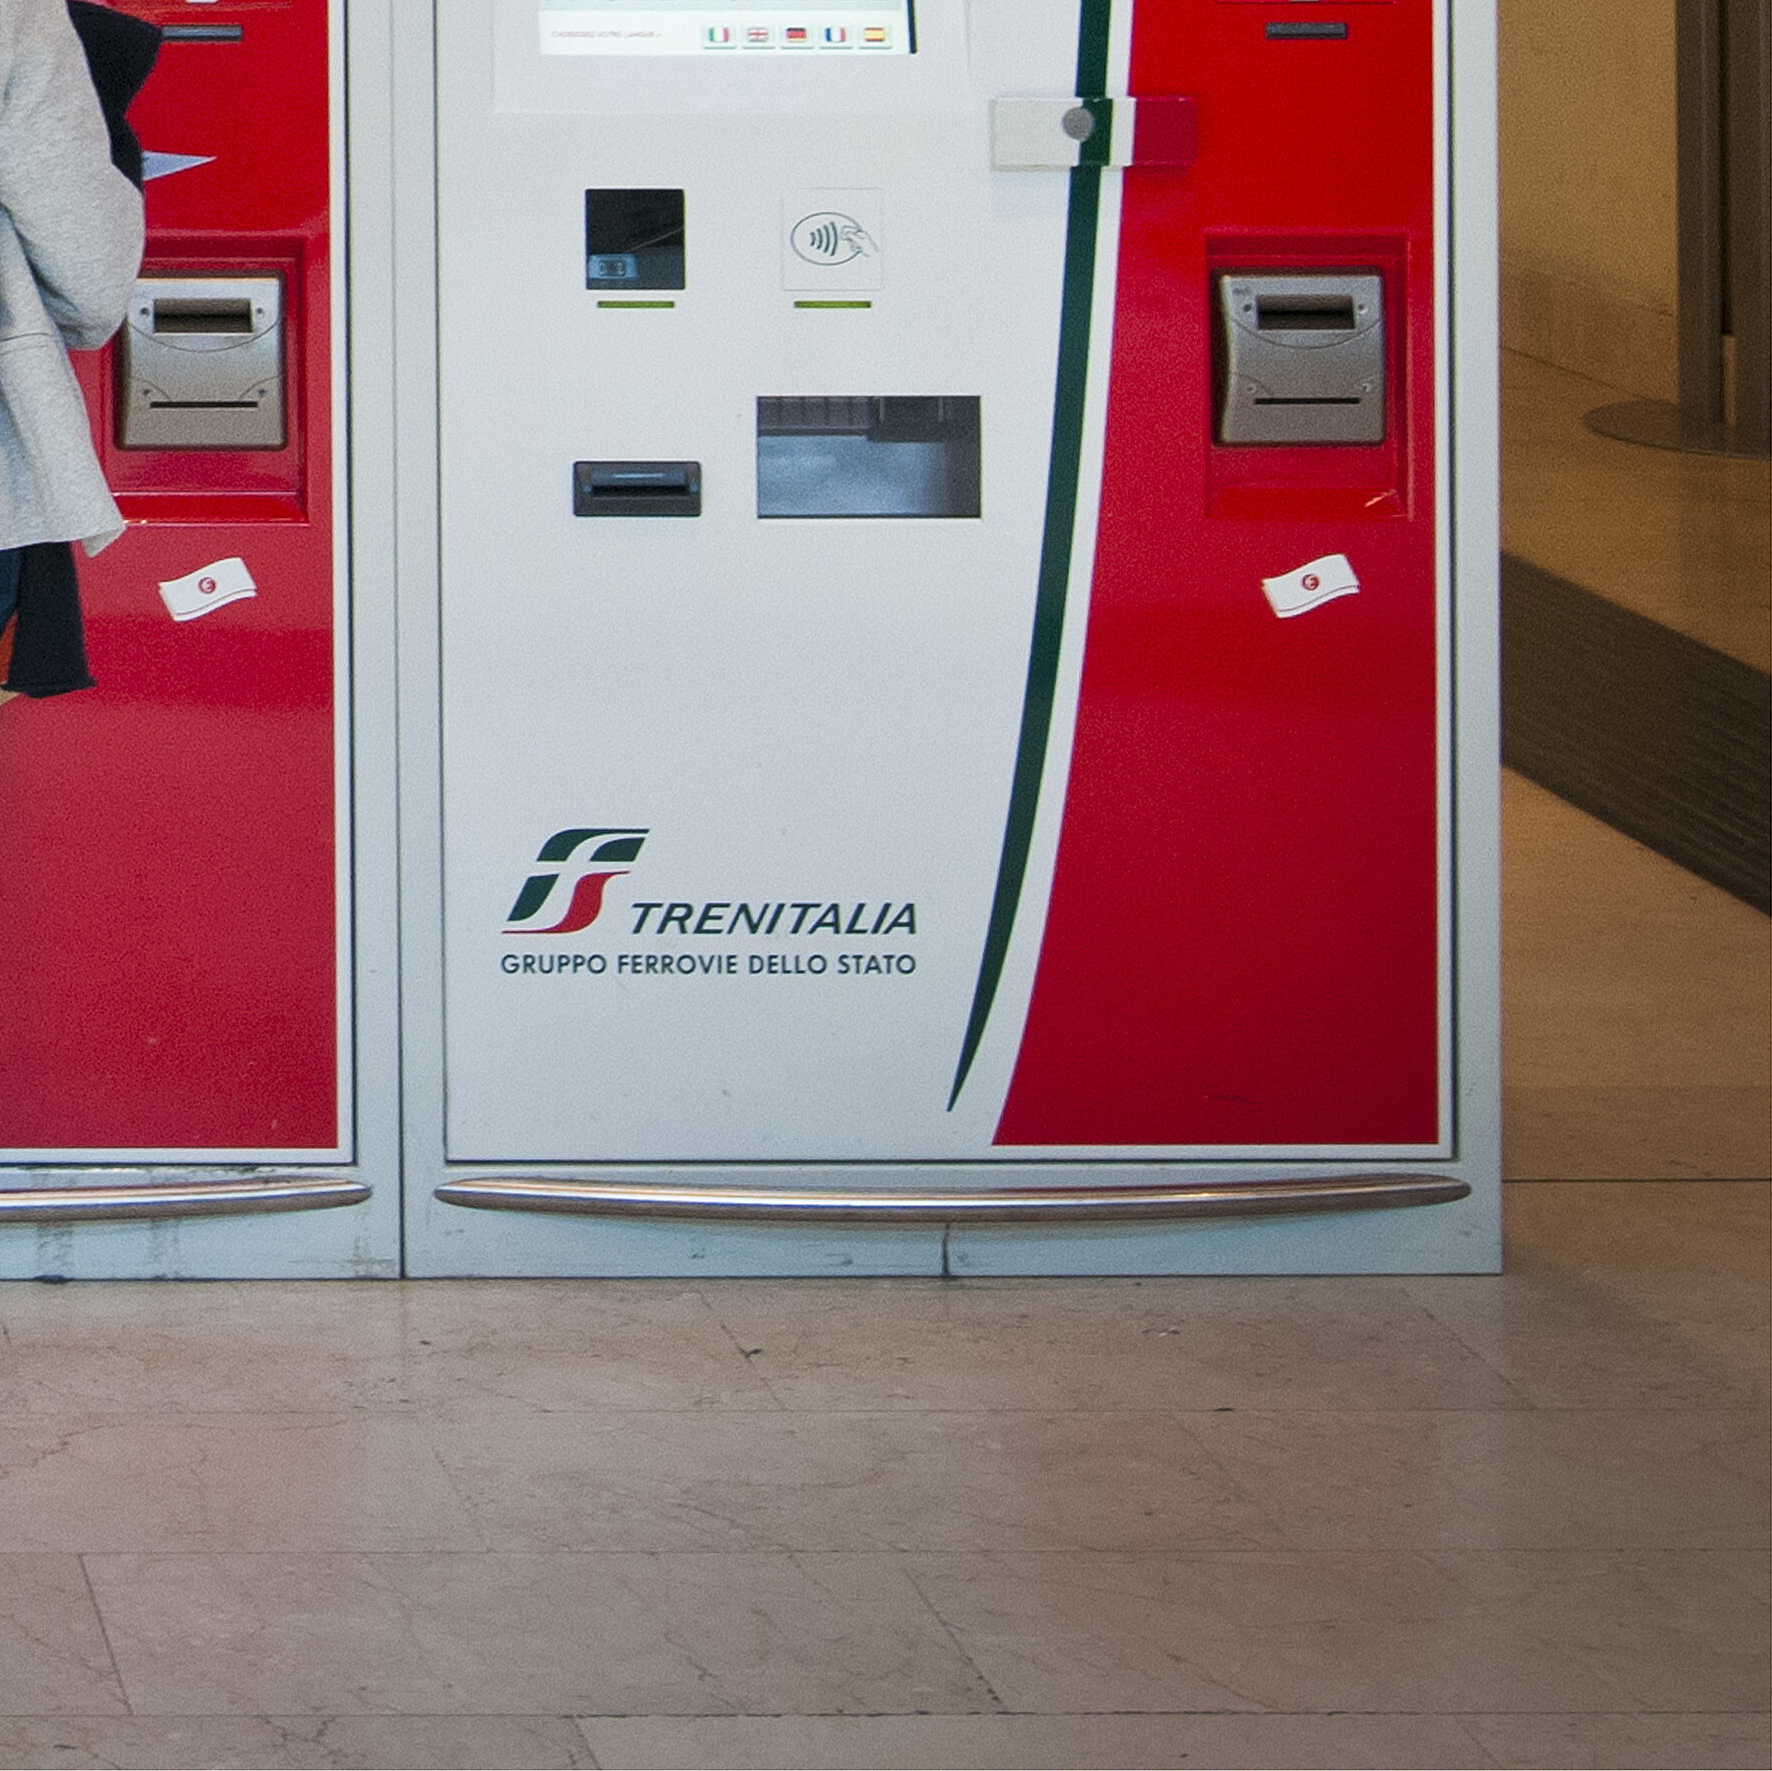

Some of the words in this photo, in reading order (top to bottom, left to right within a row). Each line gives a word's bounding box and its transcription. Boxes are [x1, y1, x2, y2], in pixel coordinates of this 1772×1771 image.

[631, 902, 917, 935] TRENITALIA
[501, 954, 607, 975] GRUPPO
[618, 954, 738, 975] FERROVIE
[749, 954, 828, 975] DELLO
[837, 954, 917, 975] STATO
